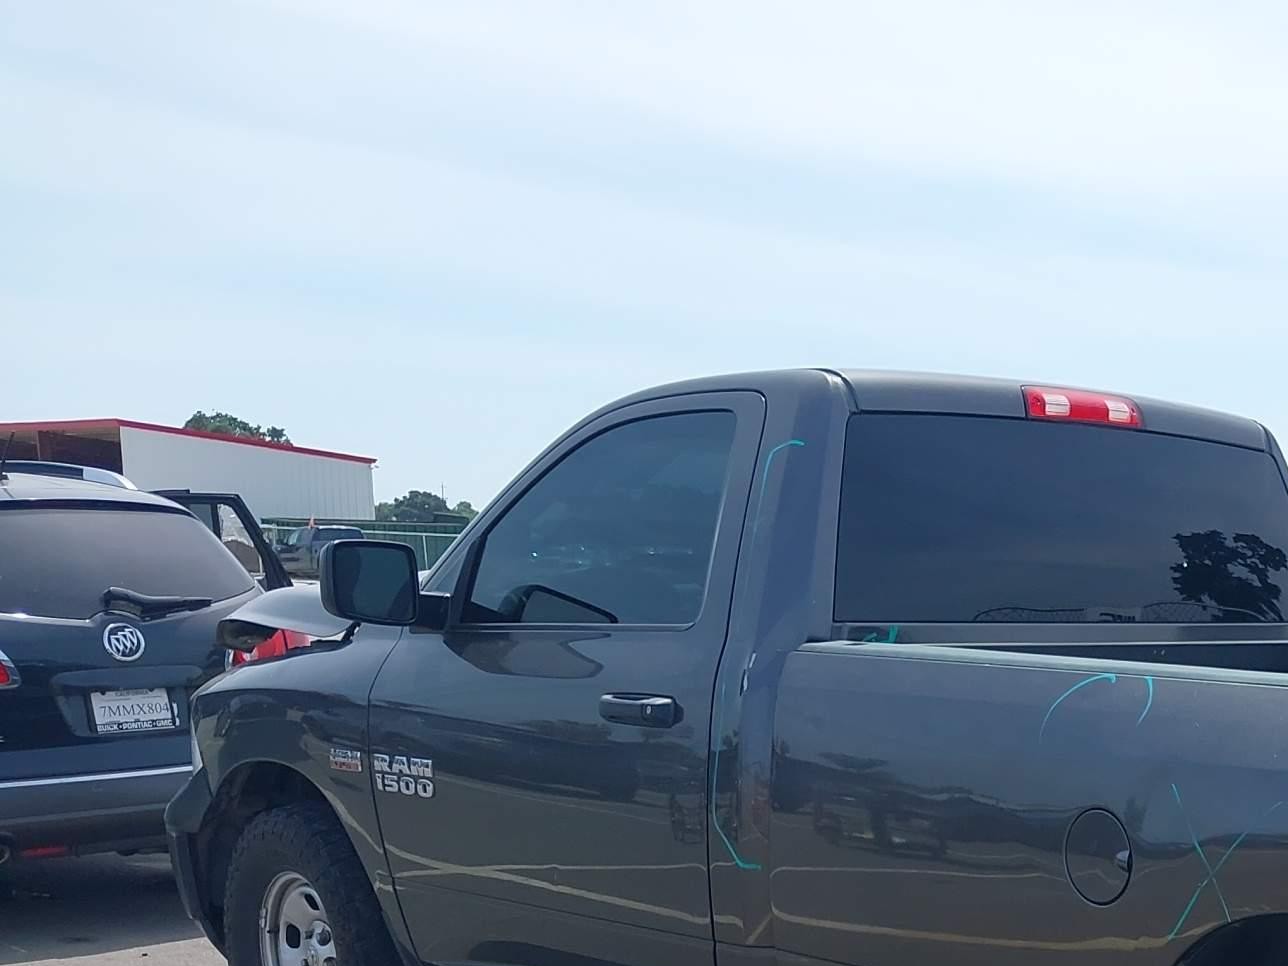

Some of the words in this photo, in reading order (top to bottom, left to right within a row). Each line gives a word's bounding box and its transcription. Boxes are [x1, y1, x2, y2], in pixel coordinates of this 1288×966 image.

[99, 702, 169, 717] 7MMX804
[373, 753, 433, 778] RAM
[375, 773, 434, 798] 1500
